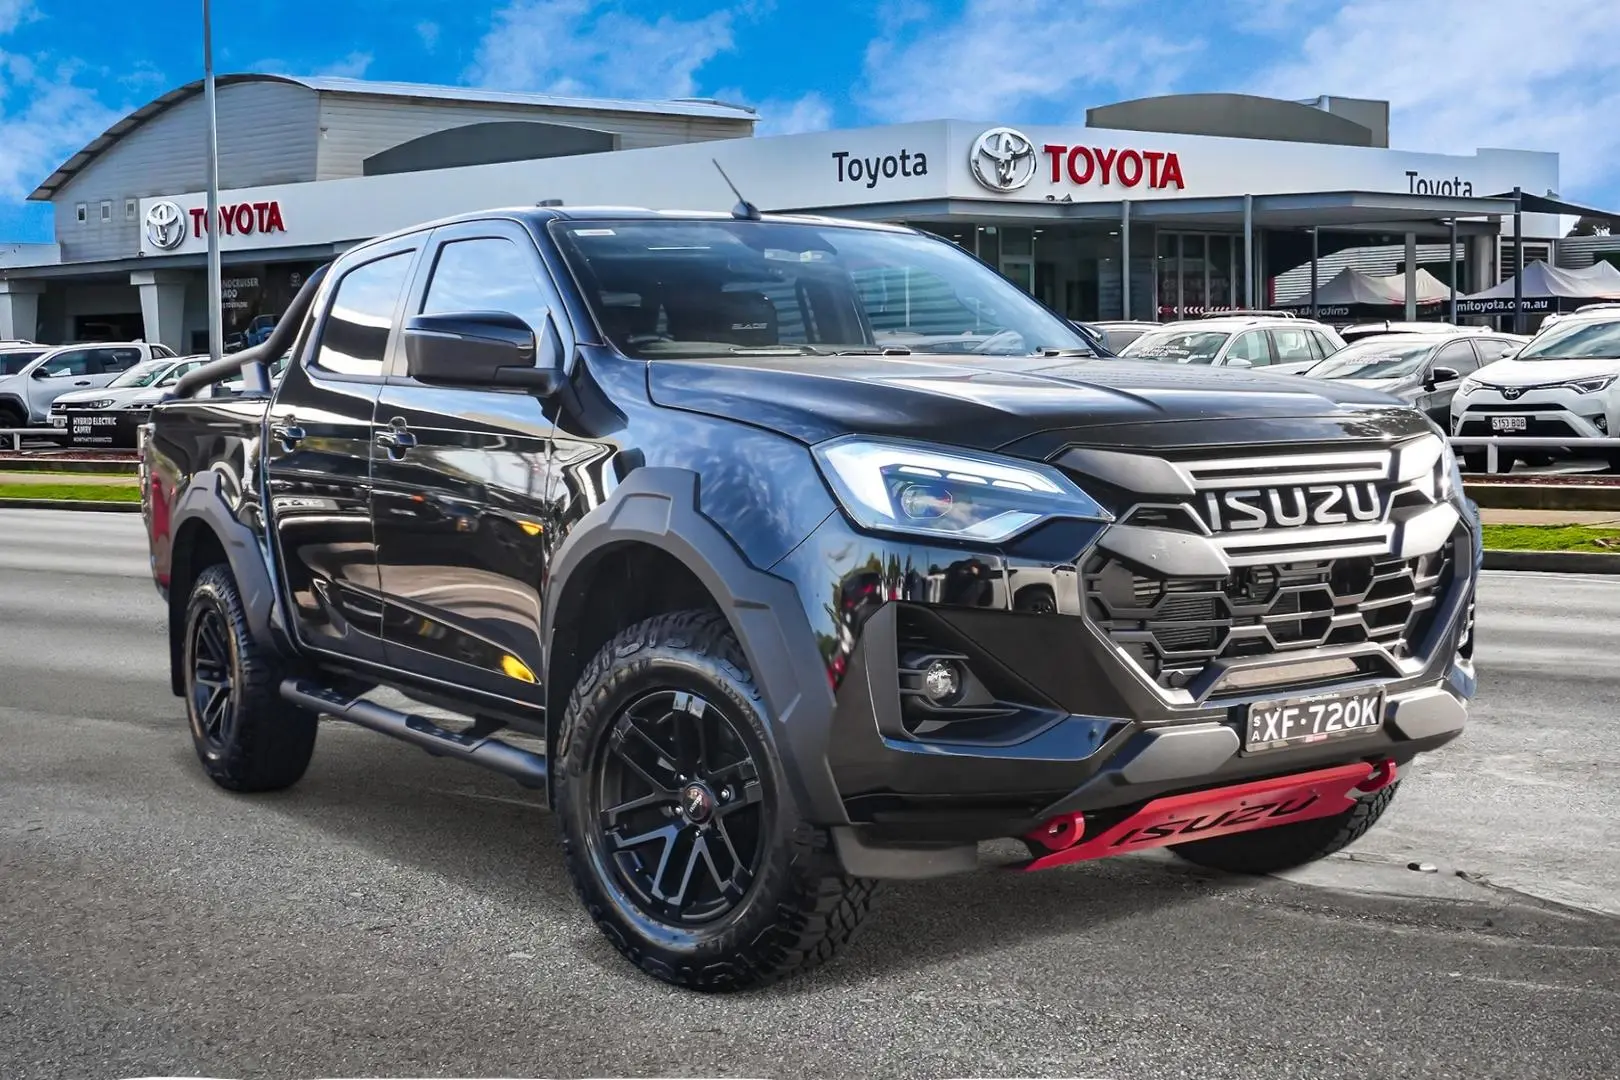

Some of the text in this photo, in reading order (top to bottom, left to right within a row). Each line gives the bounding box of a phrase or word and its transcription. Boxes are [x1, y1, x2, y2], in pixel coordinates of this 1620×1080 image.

[832, 149, 927, 189] Toyota
[1043, 144, 1185, 189] TOYOTA
[1205, 482, 1381, 531] ISUZU
[1111, 795, 1320, 847] ISUZU
